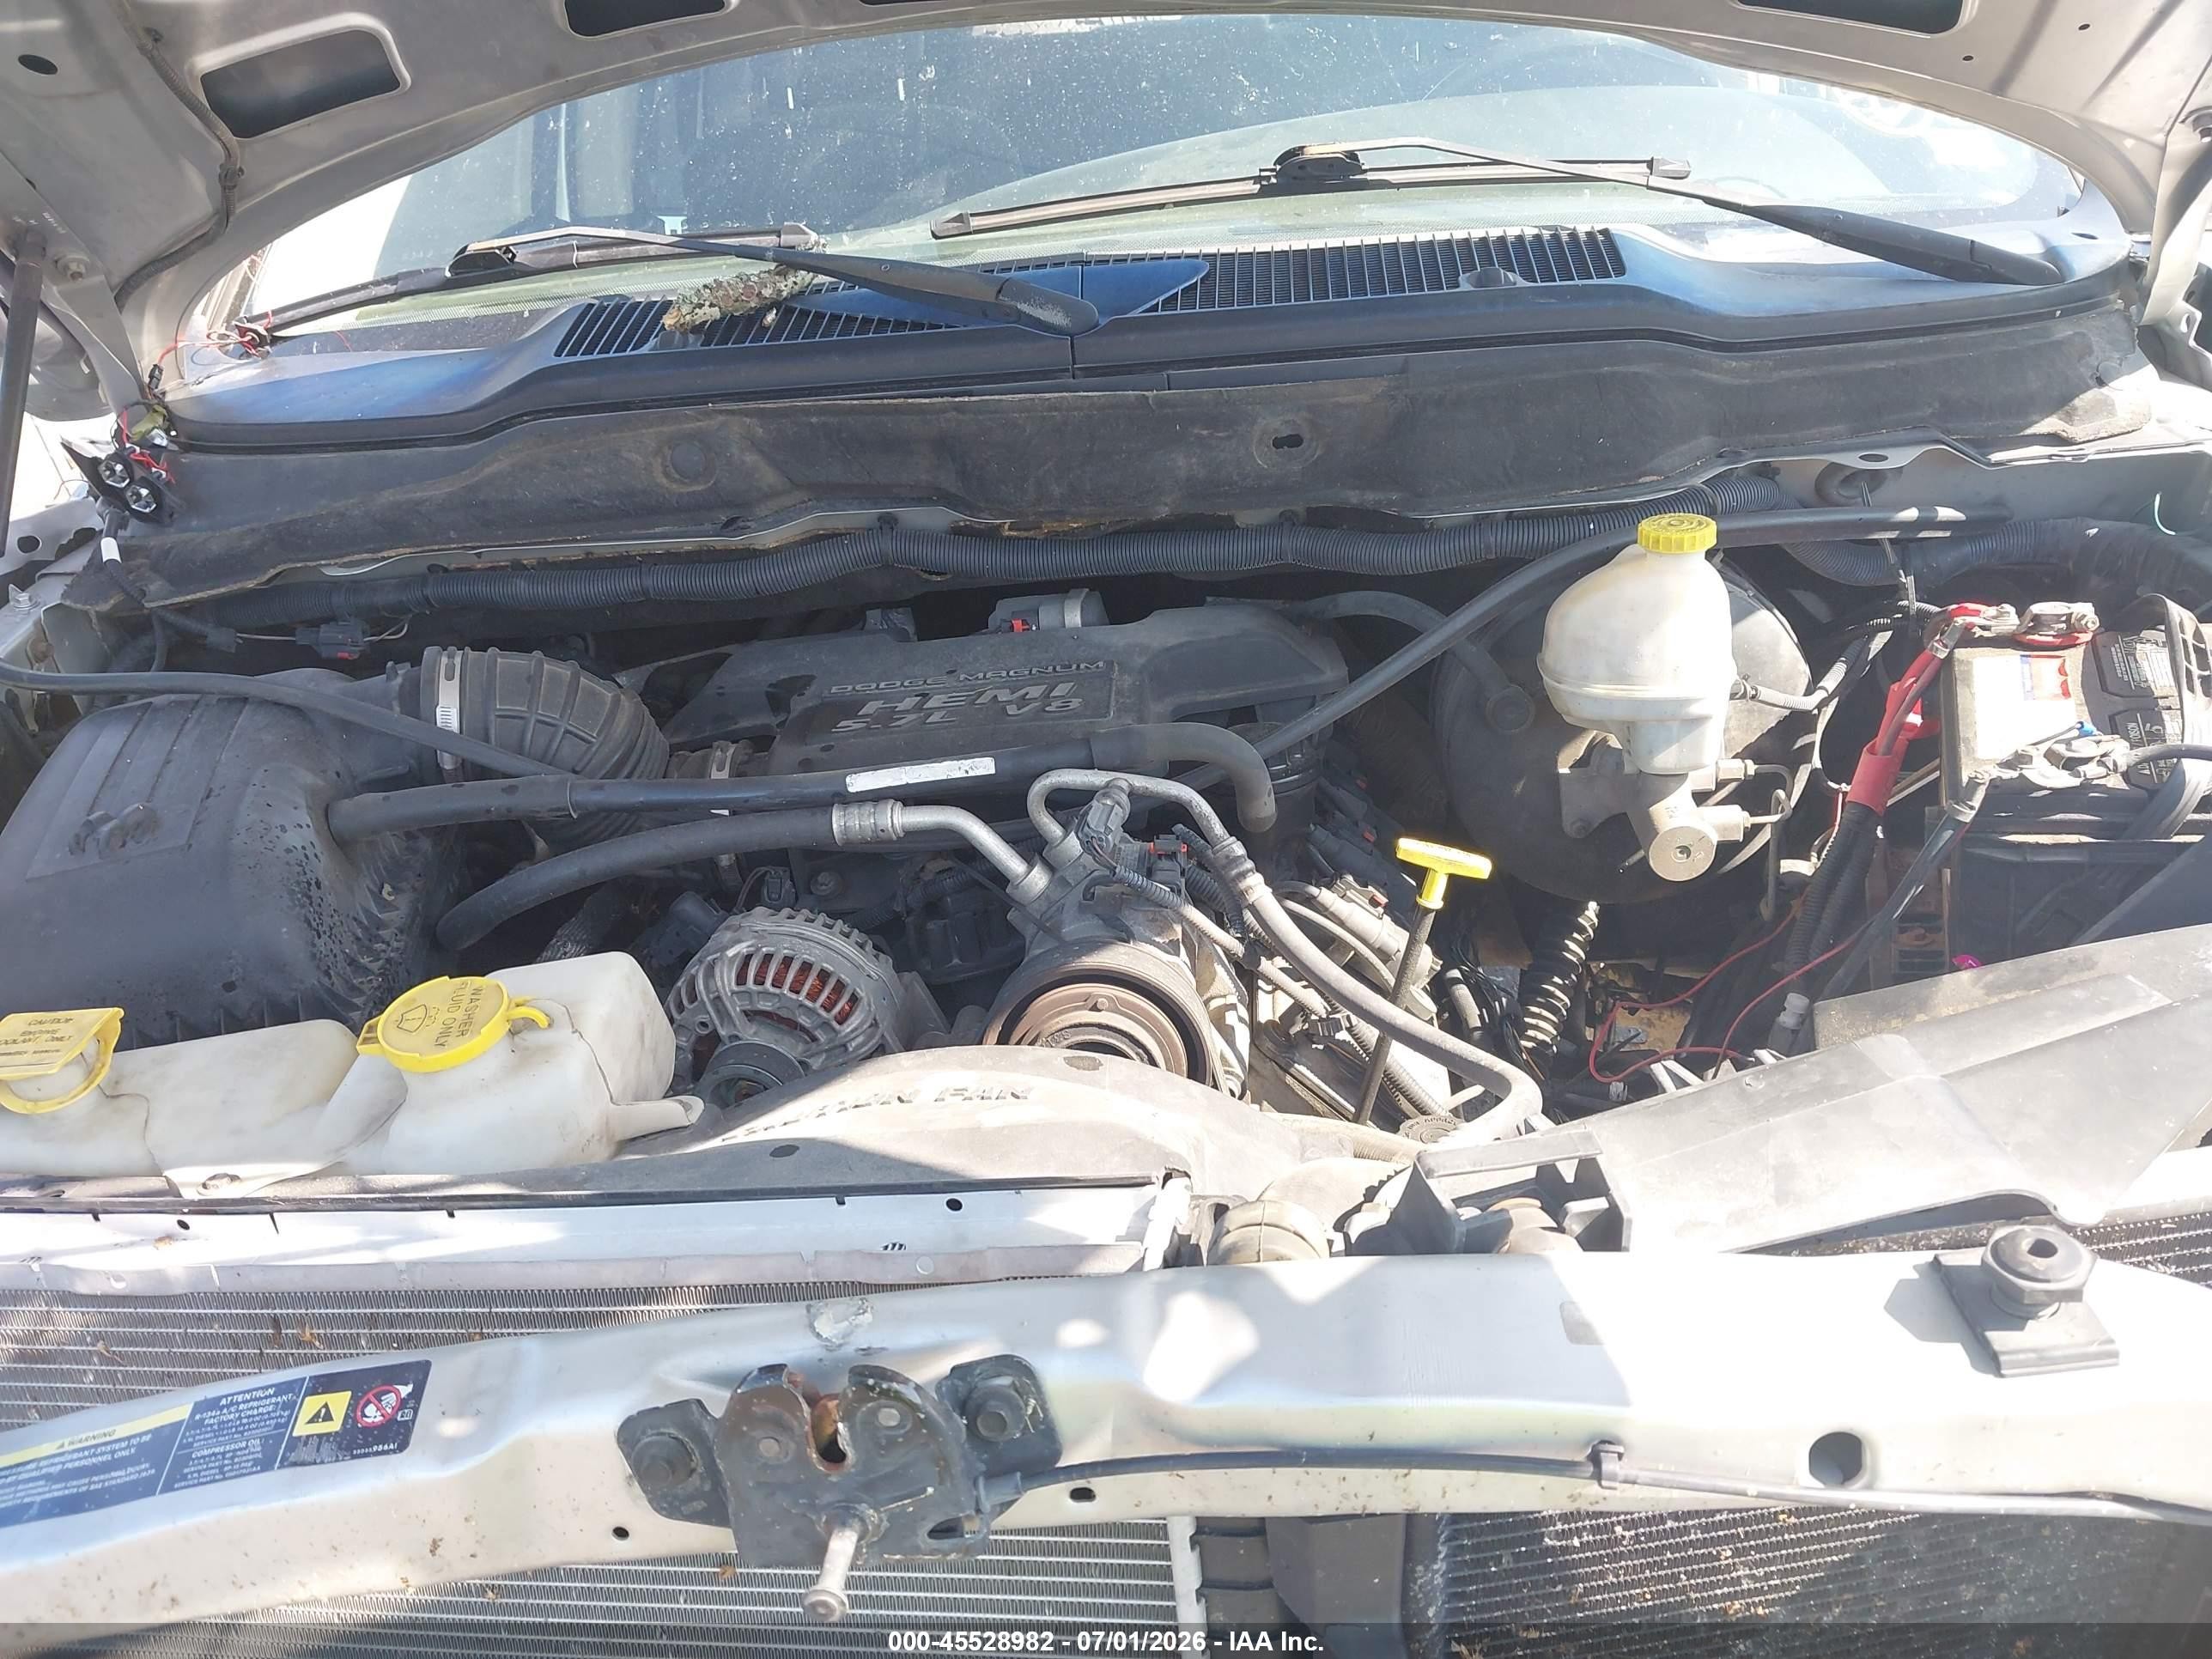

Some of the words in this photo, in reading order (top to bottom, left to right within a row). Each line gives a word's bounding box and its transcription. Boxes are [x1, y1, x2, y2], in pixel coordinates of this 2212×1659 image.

[830, 676, 948, 694] DODGE
[959, 660, 1105, 681] MAGNUM
[857, 682, 1076, 716] HEMI
[830, 710, 957, 732] 5.7L
[1005, 698, 1084, 715] V8
[447, 981, 469, 1014] FLUID
[456, 986, 483, 1037] WASHER
[434, 1017, 457, 1048] ONLY
[219, 1387, 276, 1407] ATTENTION
[238, 1393, 294, 1411] REFRIGERANT
[204, 1413, 240, 1425] FACTORY
[68, 1429, 117, 1447] WARNING
[95, 1440, 129, 1455] SYSTEM
[129, 1437, 140, 1446] TO
[191, 1441, 247, 1458] COMPRESSOR
[64, 1454, 112, 1470] PERSONNEL
